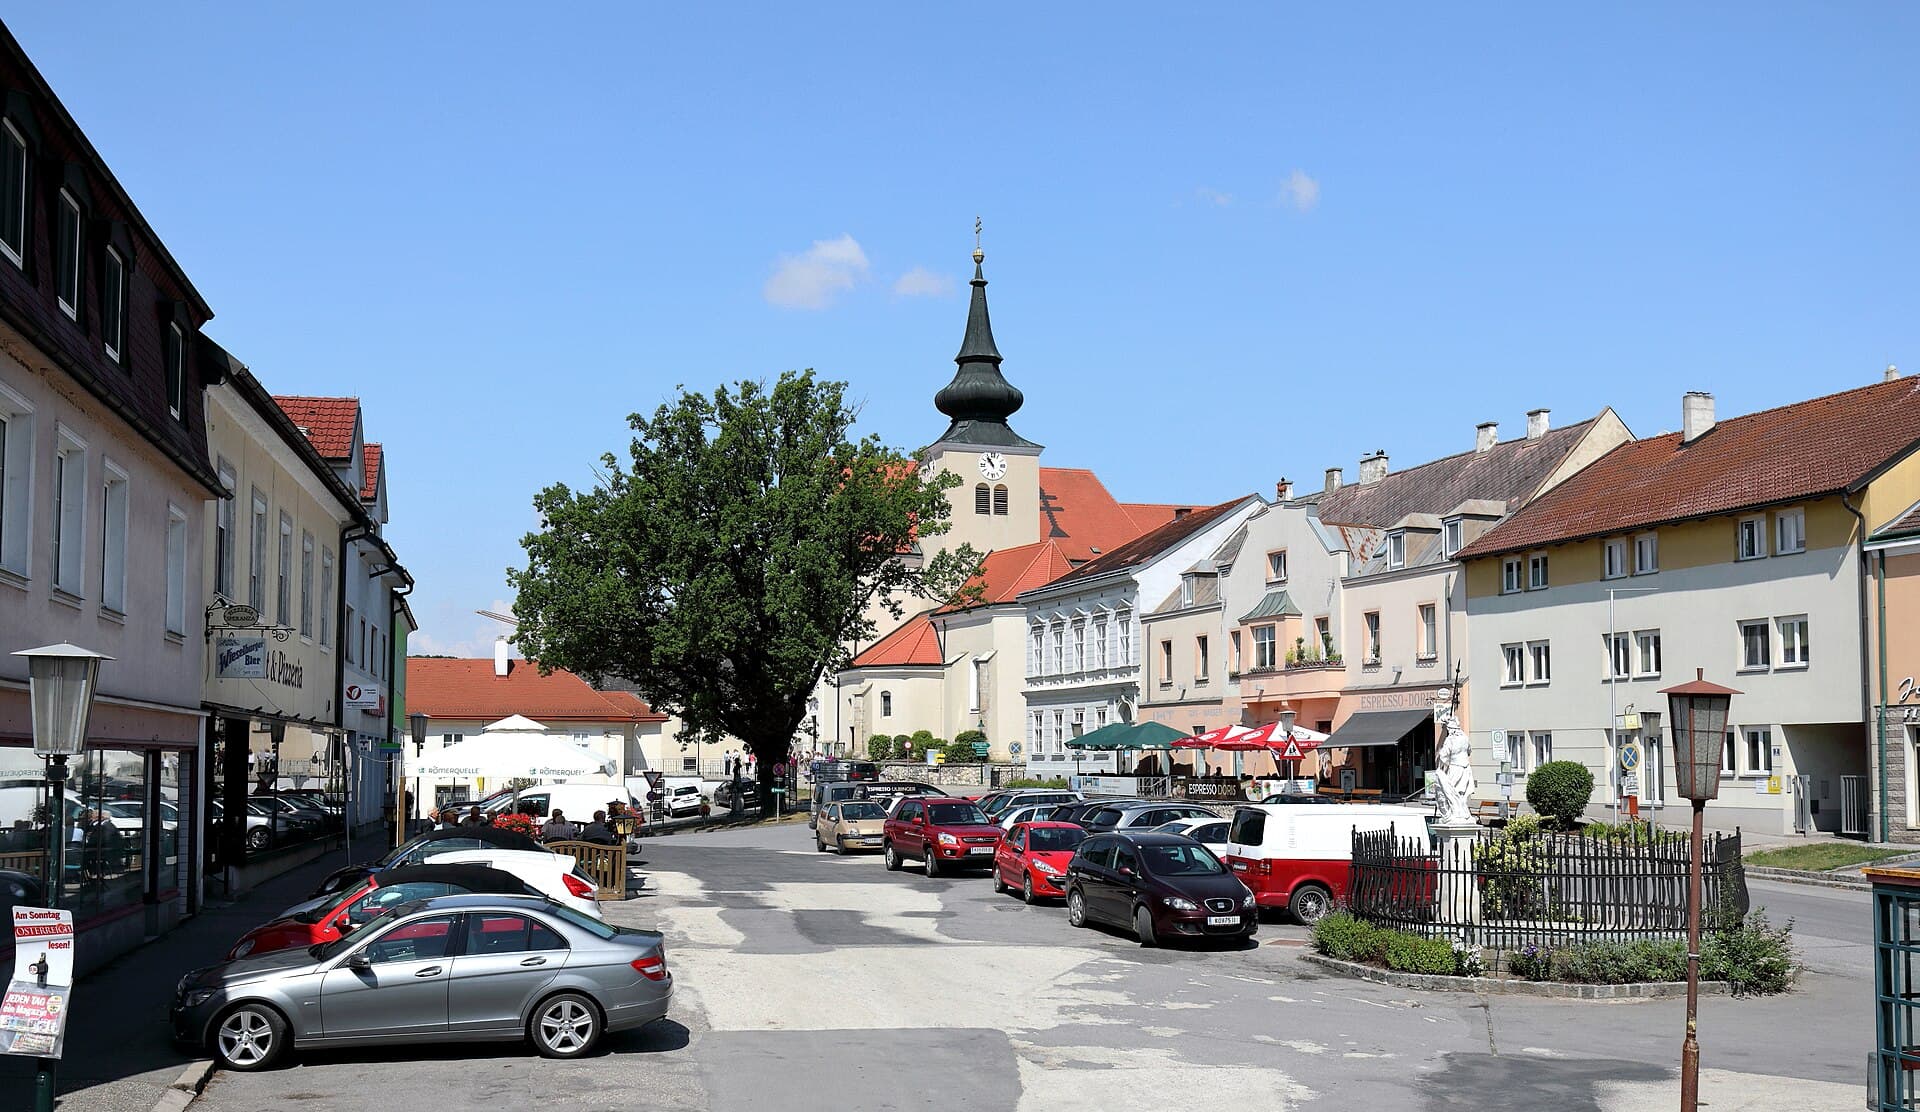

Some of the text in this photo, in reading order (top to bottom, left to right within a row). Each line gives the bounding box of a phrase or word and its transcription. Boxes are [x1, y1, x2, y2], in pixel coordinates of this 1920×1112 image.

[244, 654, 261, 666] Bier
[278, 650, 303, 689] Pizzeria
[428, 766, 480, 775] RÖMERQUELLE
[1188, 783, 1237, 796] ESPRESSO DORIS
[15, 911, 61, 920] Am Sonntag
[48, 940, 71, 949] lesen!
[6, 993, 30, 1004] JEDEN
